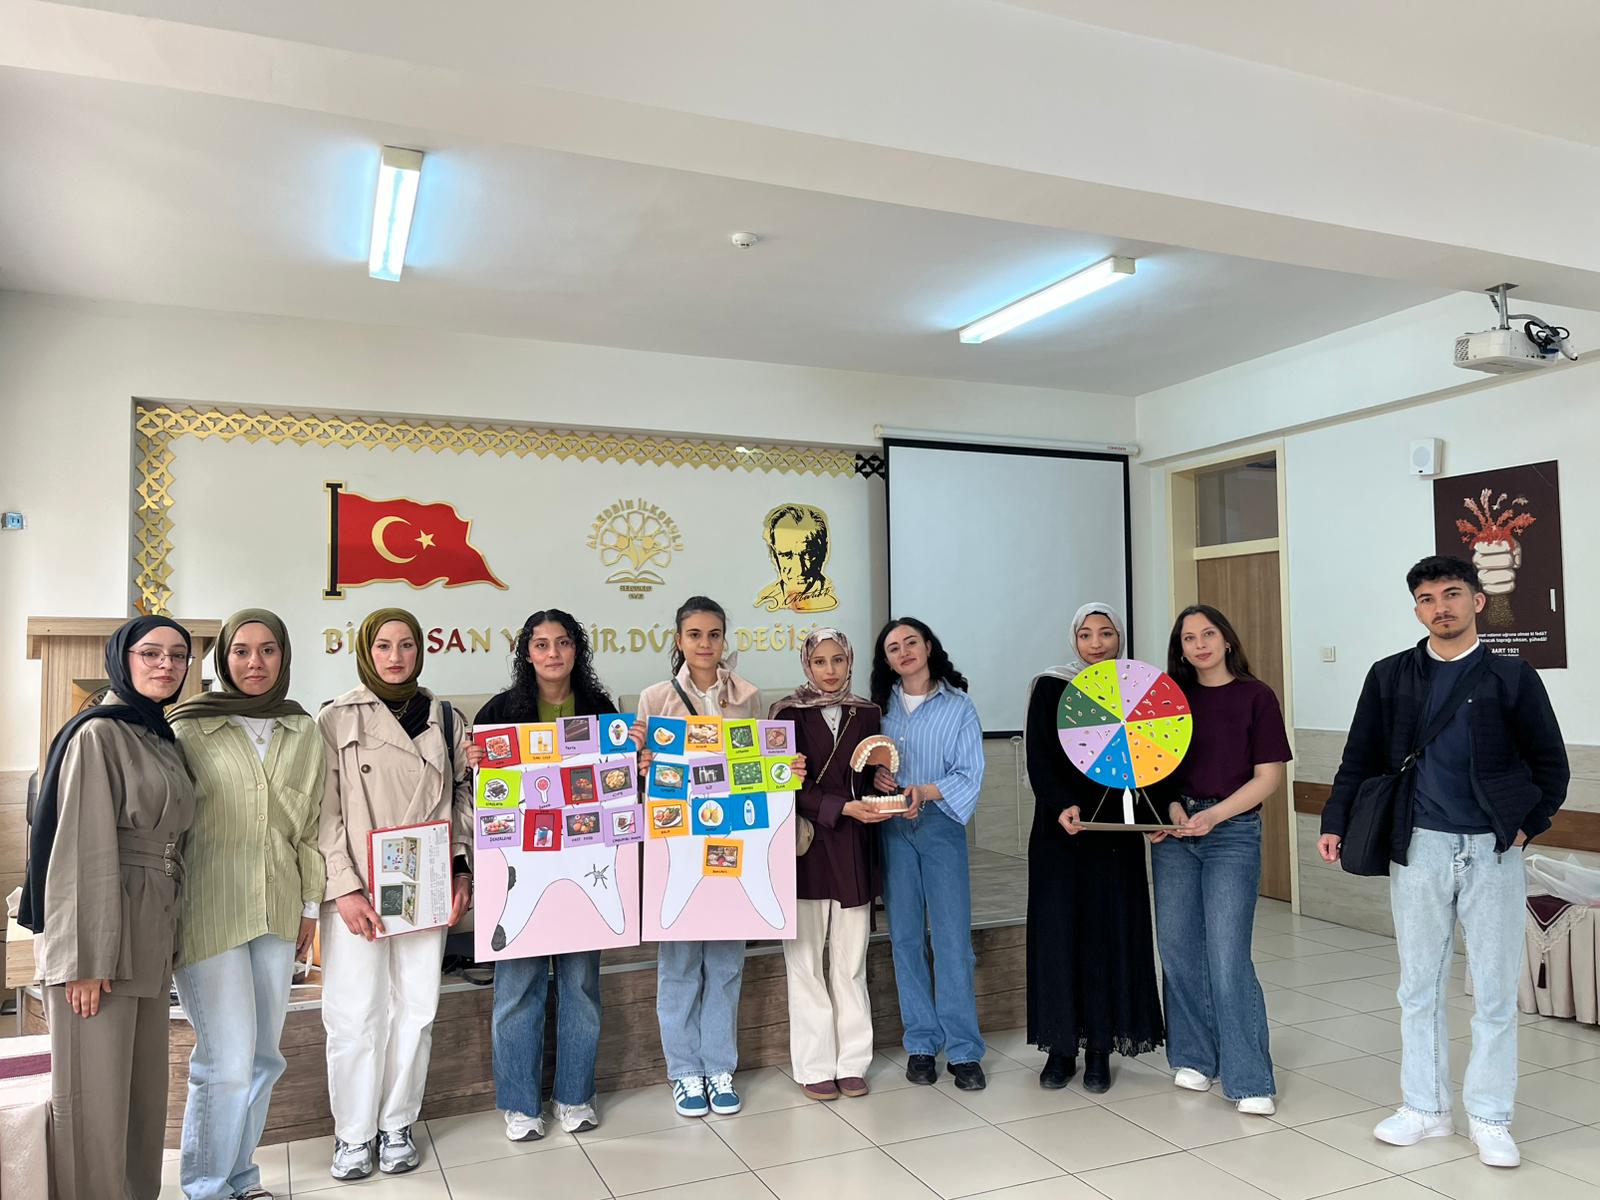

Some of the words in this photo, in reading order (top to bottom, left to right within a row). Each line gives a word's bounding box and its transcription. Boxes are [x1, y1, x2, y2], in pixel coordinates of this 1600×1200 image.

[637, 497, 684, 552] İLKOKULU
[322, 621, 359, 655] Bİ
[426, 627, 492, 655] SAN
